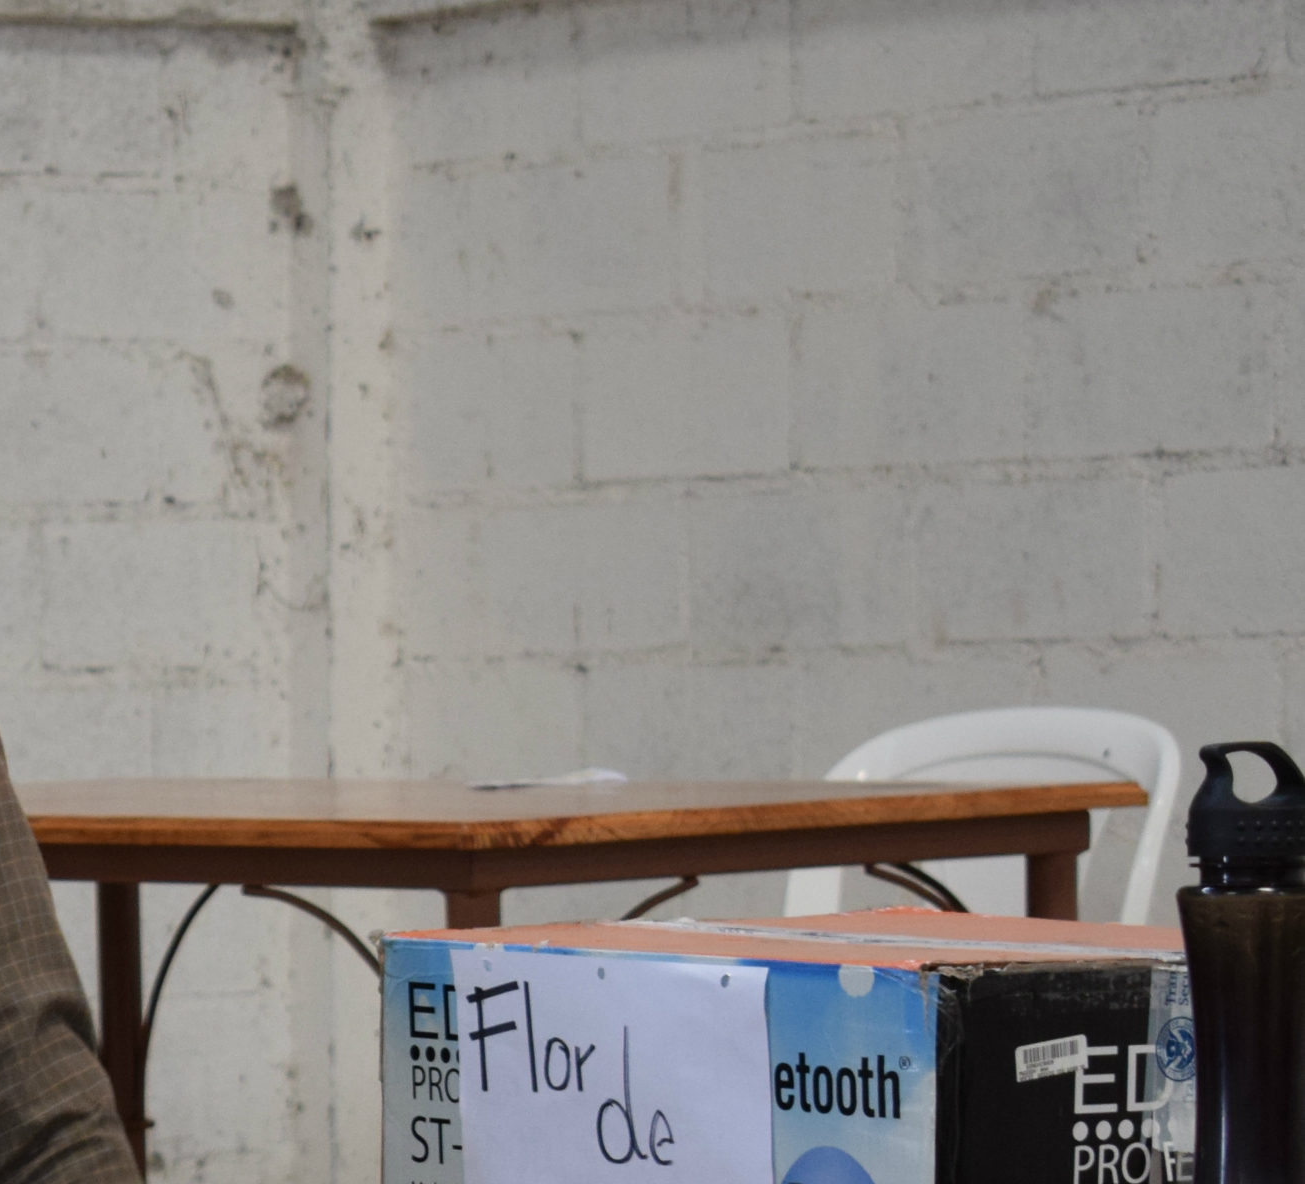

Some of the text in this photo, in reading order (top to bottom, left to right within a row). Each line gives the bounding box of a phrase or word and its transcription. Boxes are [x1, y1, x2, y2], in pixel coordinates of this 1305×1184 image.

[466, 981, 596, 1093] Flor
[774, 1052, 901, 1120] etooth
[596, 1025, 675, 1166] de
